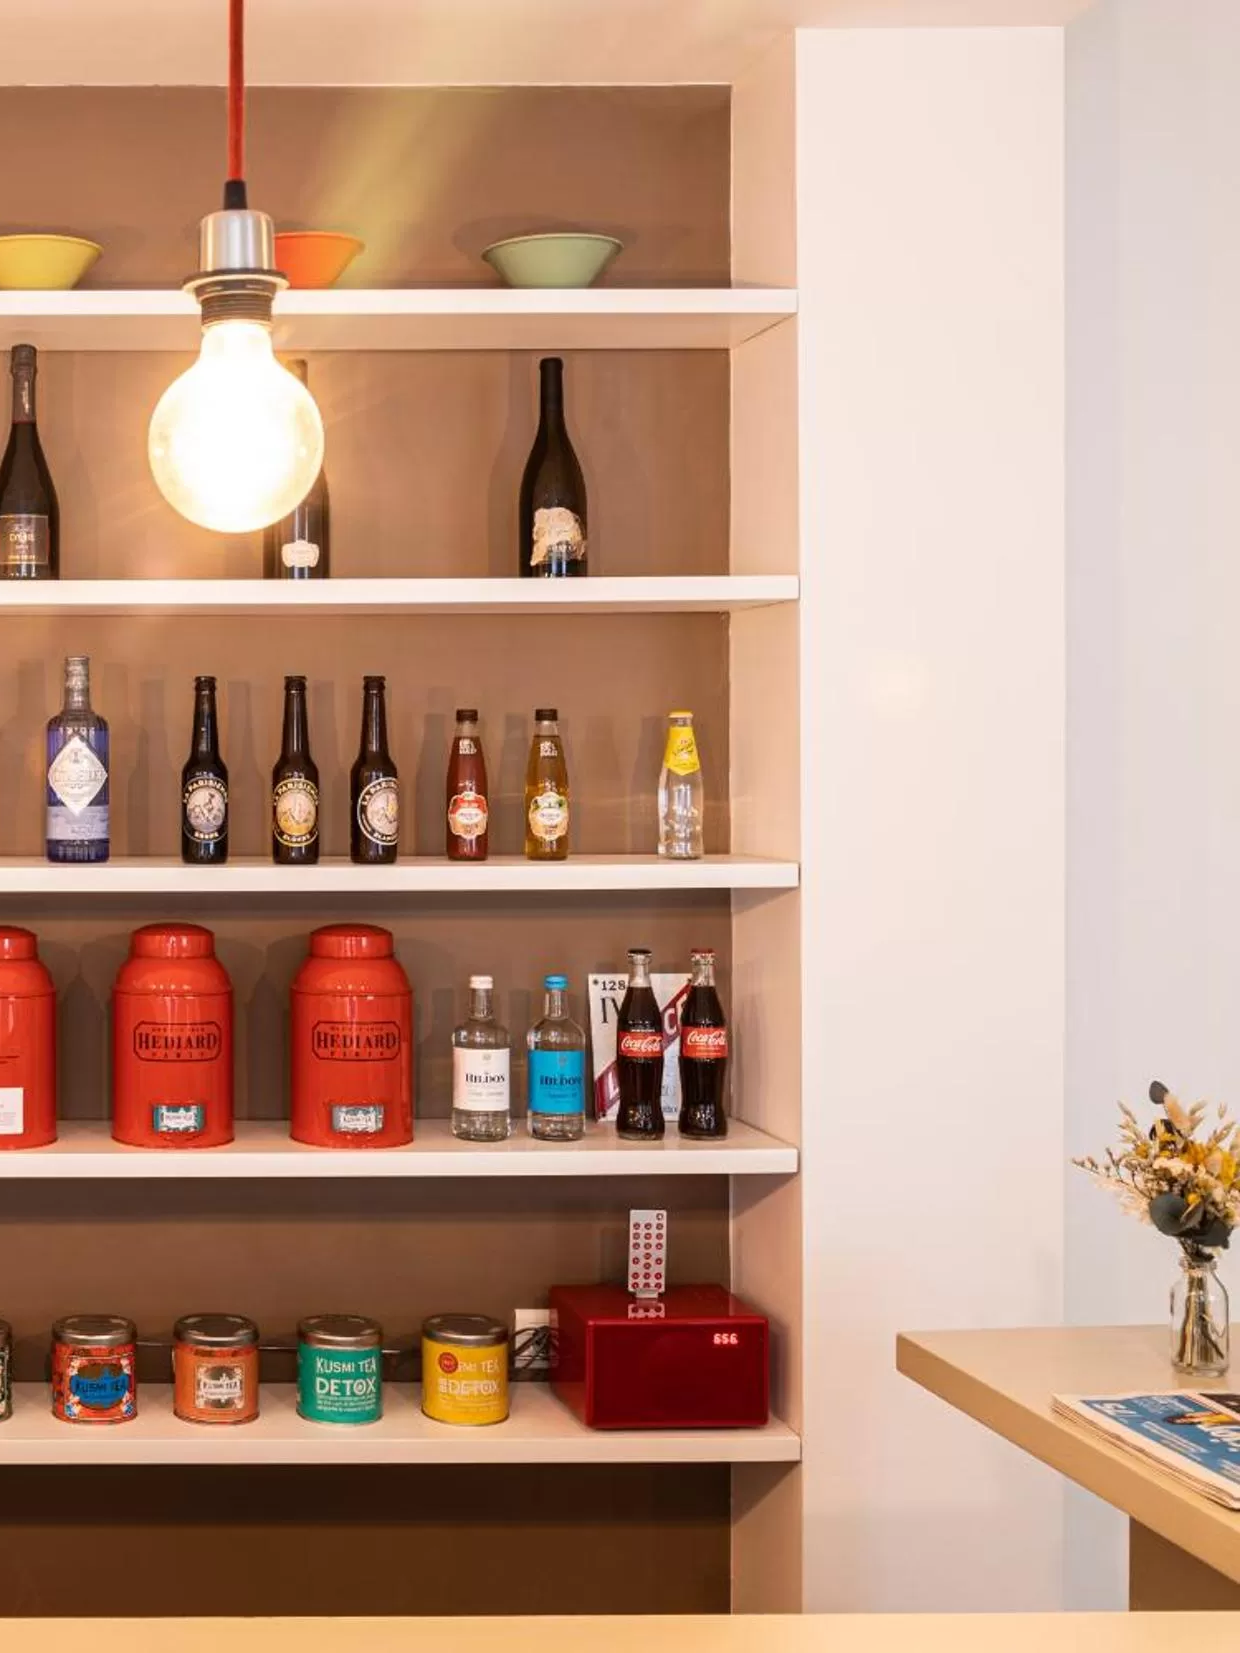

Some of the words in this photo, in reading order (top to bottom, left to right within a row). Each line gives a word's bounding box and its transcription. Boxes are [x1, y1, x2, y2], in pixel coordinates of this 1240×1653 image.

[601, 980, 626, 991] 128
[138, 1032, 218, 1050] HEDIARD
[316, 1031, 397, 1049] HEDIARD
[316, 1356, 356, 1374] KUSMI
[357, 1356, 376, 1373] TEA
[315, 1376, 377, 1396] DETOX
